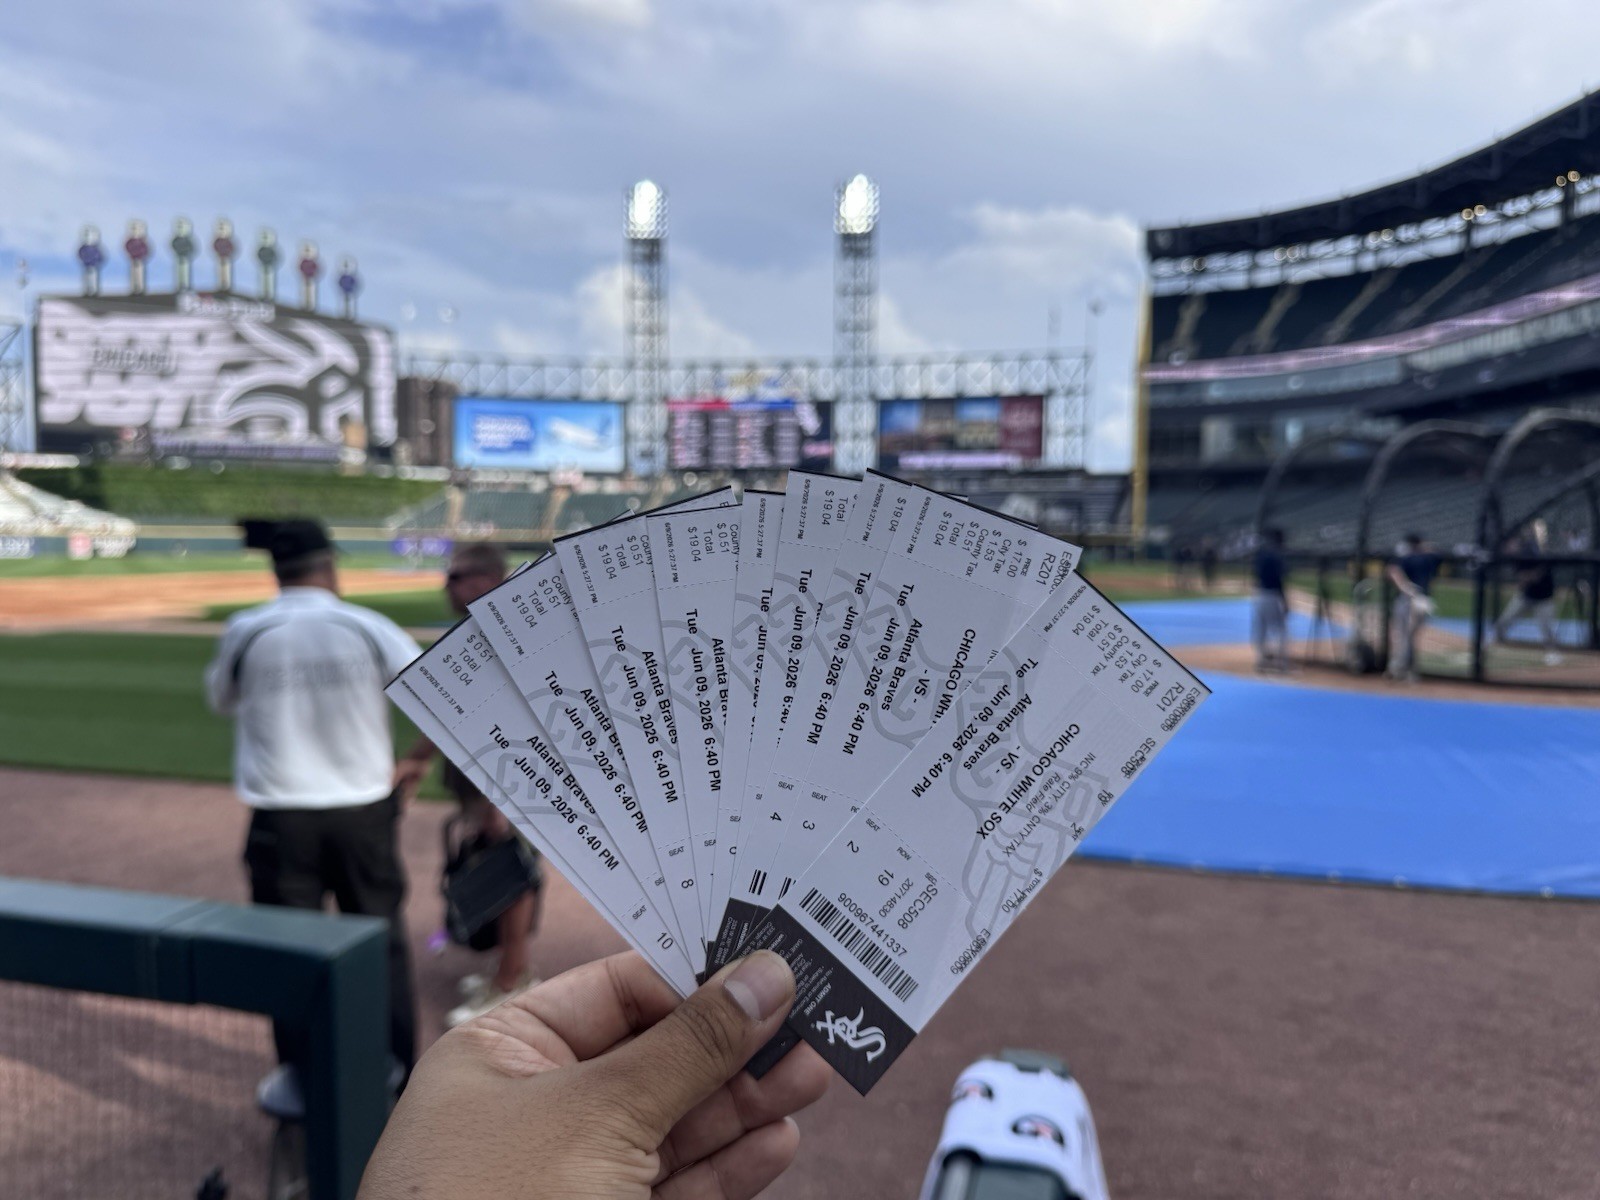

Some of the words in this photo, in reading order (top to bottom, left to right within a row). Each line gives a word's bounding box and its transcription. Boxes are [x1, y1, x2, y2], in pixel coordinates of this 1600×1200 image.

[836, 497, 848, 522] Total
[703, 528, 715, 554] Total
[717, 531, 730, 553] 0.51
[729, 523, 740, 555] County
[910, 520, 922, 543] 5:27:37
[948, 522, 964, 546] Total
[961, 529, 976, 551] 0.51
[629, 544, 644, 566] 0.51
[906, 543, 914, 554] PM
[969, 528, 989, 559] County
[983, 541, 997, 561] 1.53
[997, 538, 1011, 556] City
[614, 543, 630, 570] Total
[667, 548, 677, 571] 5:27:37
[672, 572, 678, 583] PM
[992, 558, 1005, 574] Tax
[1006, 551, 1022, 578] 17.00
[1019, 557, 1031, 576] PRICE
[964, 561, 978, 577] Tax
[1035, 552, 1056, 585] RZ01
[550, 575, 573, 605] County
[797, 568, 812, 593] Tue
[853, 572, 871, 595] Tue
[528, 589, 548, 616] Total
[542, 586, 561, 608] 0.51
[589, 592, 598, 604] PM
[759, 587, 773, 612] Tue
[896, 584, 914, 606] Tue
[685, 608, 697, 634] Tue
[792, 605, 806, 631] Jun
[842, 605, 858, 630] Jun
[501, 624, 518, 645] 5:27:37
[514, 645, 524, 655] PM
[611, 625, 626, 652] Tue
[882, 617, 899, 642] Jun
[897, 618, 922, 663] Atlanta
[1085, 619, 1109, 641] Total
[1096, 631, 1116, 651] 0.51
[473, 641, 494, 662] 0.51
[787, 634, 803, 653] 09,
[833, 633, 850, 651] 09,
[874, 644, 891, 661] 09,
[1103, 635, 1129, 662] County
[458, 646, 481, 672] Total
[690, 647, 703, 673] Jun
[711, 637, 727, 685] Atlanta
[824, 654, 843, 686] 2026
[944, 628, 975, 690] CHICAGO
[1015, 657, 1038, 678] Tue
[1090, 661, 1107, 676] Tax
[1114, 649, 1133, 669] 1.53
[1130, 653, 1147, 669] City
[622, 664, 638, 689] Jun
[784, 657, 799, 688] 2026
[863, 665, 882, 697] 2026
[1117, 669, 1135, 683] Tax
[1130, 668, 1153, 693] 17.00
[641, 651, 664, 697] Atlanta
[657, 698, 677, 744] Braves
[695, 676, 708, 696] 09,
[880, 666, 906, 711] Braves
[913, 678, 929, 696] VS
[989, 684, 1010, 706] Jun
[1142, 680, 1159, 697] PRICE
[1155, 681, 1185, 712] RZ01
[453, 704, 464, 715] PM
[579, 688, 612, 732] Atlanta
[632, 691, 647, 712] 09,
[814, 692, 832, 720] 6:40
[995, 692, 1032, 732] Atlanta
[698, 699, 713, 730] 2026
[850, 702, 869, 731] 6:40
[973, 706, 993, 722] 09,
[639, 713, 658, 744] 2026
[806, 722, 823, 744] PM
[951, 722, 977, 751] 2026
[544, 670, 563, 697] Tue
[564, 707, 584, 730] Jun
[580, 730, 597, 752] 09,
[592, 750, 617, 780] 2026
[613, 783, 636, 811] 6:40
[630, 810, 648, 833] PM
[703, 737, 718, 766] 6:40
[841, 732, 858, 755] PM
[962, 731, 1000, 770] Braves
[1031, 723, 1079, 776] CHICAGO
[651, 749, 669, 778] 6:40
[928, 752, 952, 778] 6:40
[999, 751, 1019, 769] VS
[1079, 751, 1096, 769] INC
[526, 735, 564, 776] Atlanta
[562, 772, 596, 814] Braves
[708, 769, 721, 791] PM
[777, 780, 794, 790] SEAT
[1042, 771, 1061, 791] Rate
[1067, 766, 1082, 781] 9%
[488, 724, 509, 749] Tue
[513, 757, 536, 780] Jun
[534, 777, 551, 799] 09,
[550, 795, 578, 824] 2026
[576, 824, 601, 851] 6:40
[597, 848, 619, 870] PM
[661, 780, 678, 803] PM
[810, 791, 827, 801] SEAT
[910, 775, 931, 797] PM
[997, 774, 1035, 814] WHITE
[1025, 789, 1045, 812] Field
[1037, 801, 1053, 815] 3%
[769, 811, 781, 821] 4
[801, 819, 815, 830] 3
[865, 817, 880, 831] SEAT
[975, 811, 1002, 839] SOX
[1018, 814, 1040, 840] CNTY
[668, 845, 684, 857] SEAT
[846, 839, 859, 853] 2
[1001, 838, 1021, 857] TAX
[680, 878, 694, 889] 8
[877, 869, 894, 886] 19
[631, 904, 646, 920] SEAT
[896, 883, 937, 929] SEC508
[836, 892, 907, 956] 900967441337
[656, 932, 674, 950] 10
[803, 1000, 816, 1015] ONE
